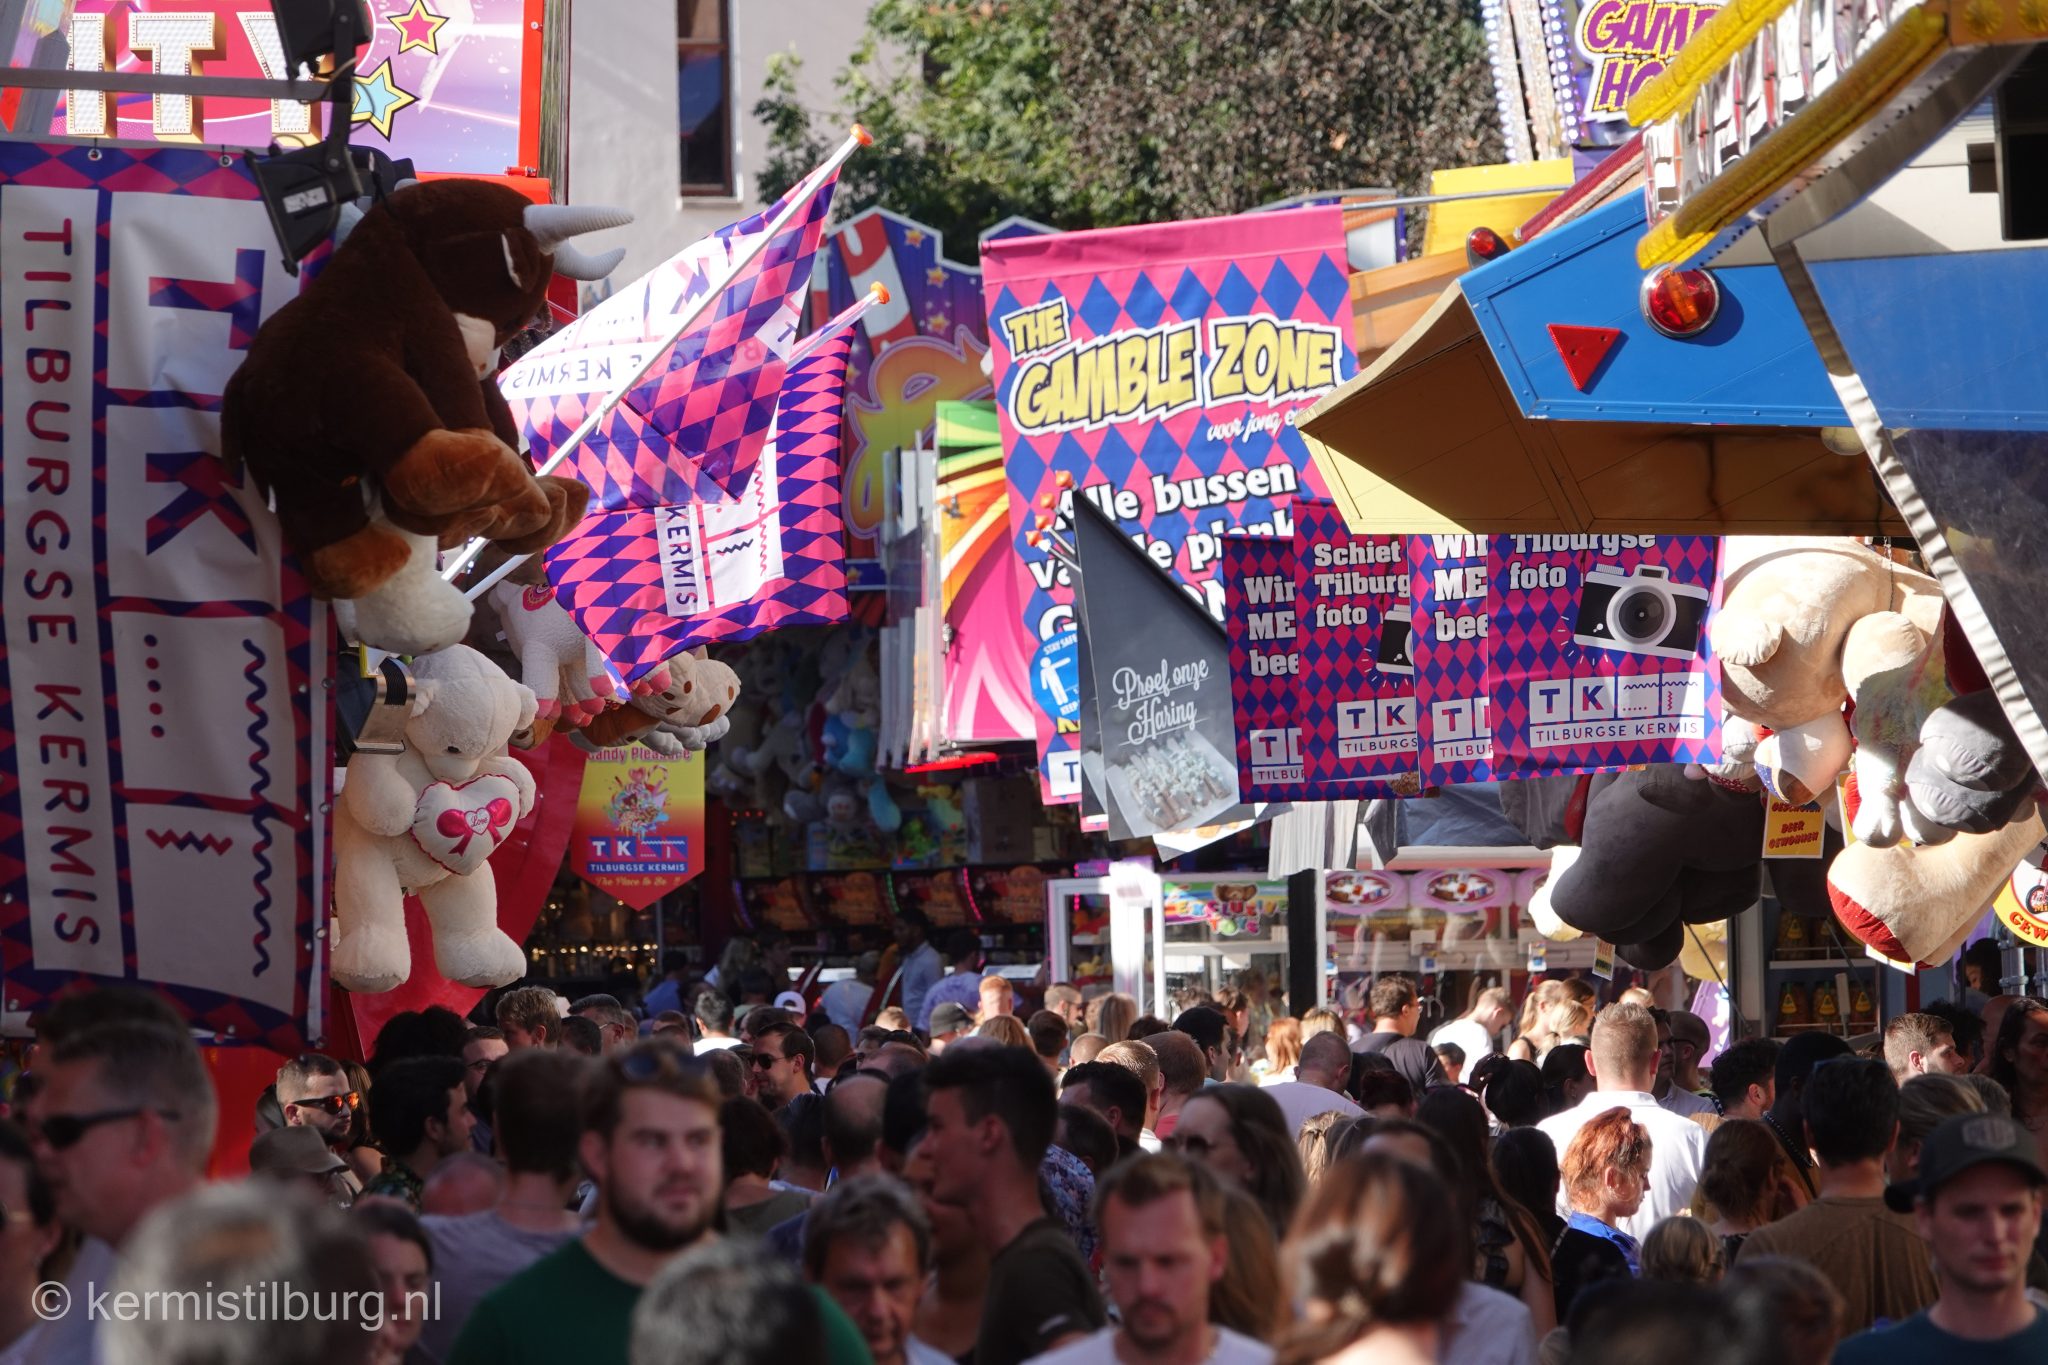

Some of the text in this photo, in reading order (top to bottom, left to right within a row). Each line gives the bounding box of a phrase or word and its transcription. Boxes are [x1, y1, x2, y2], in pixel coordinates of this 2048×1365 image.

[1005, 300, 1068, 358] THE
[1013, 318, 1339, 430] GAMBLE ZONE
[1207, 418, 1244, 441] voor
[1242, 412, 1282, 443] jong
[1152, 463, 1297, 514] bussen
[665, 505, 698, 605] KERMIS
[1314, 541, 1401, 567] Schiet
[23, 217, 100, 945] TILBURGSE KERMIS
[1510, 562, 1566, 589] foto
[1316, 603, 1368, 628] foto
[1113, 658, 1208, 710] Proef onze
[1128, 696, 1197, 745] Haring
[1536, 722, 1698, 742] TILBURGSE KERMIS
[471, 814, 488, 828] Love
[590, 863, 685, 872] TILBURGSE KERMIS
